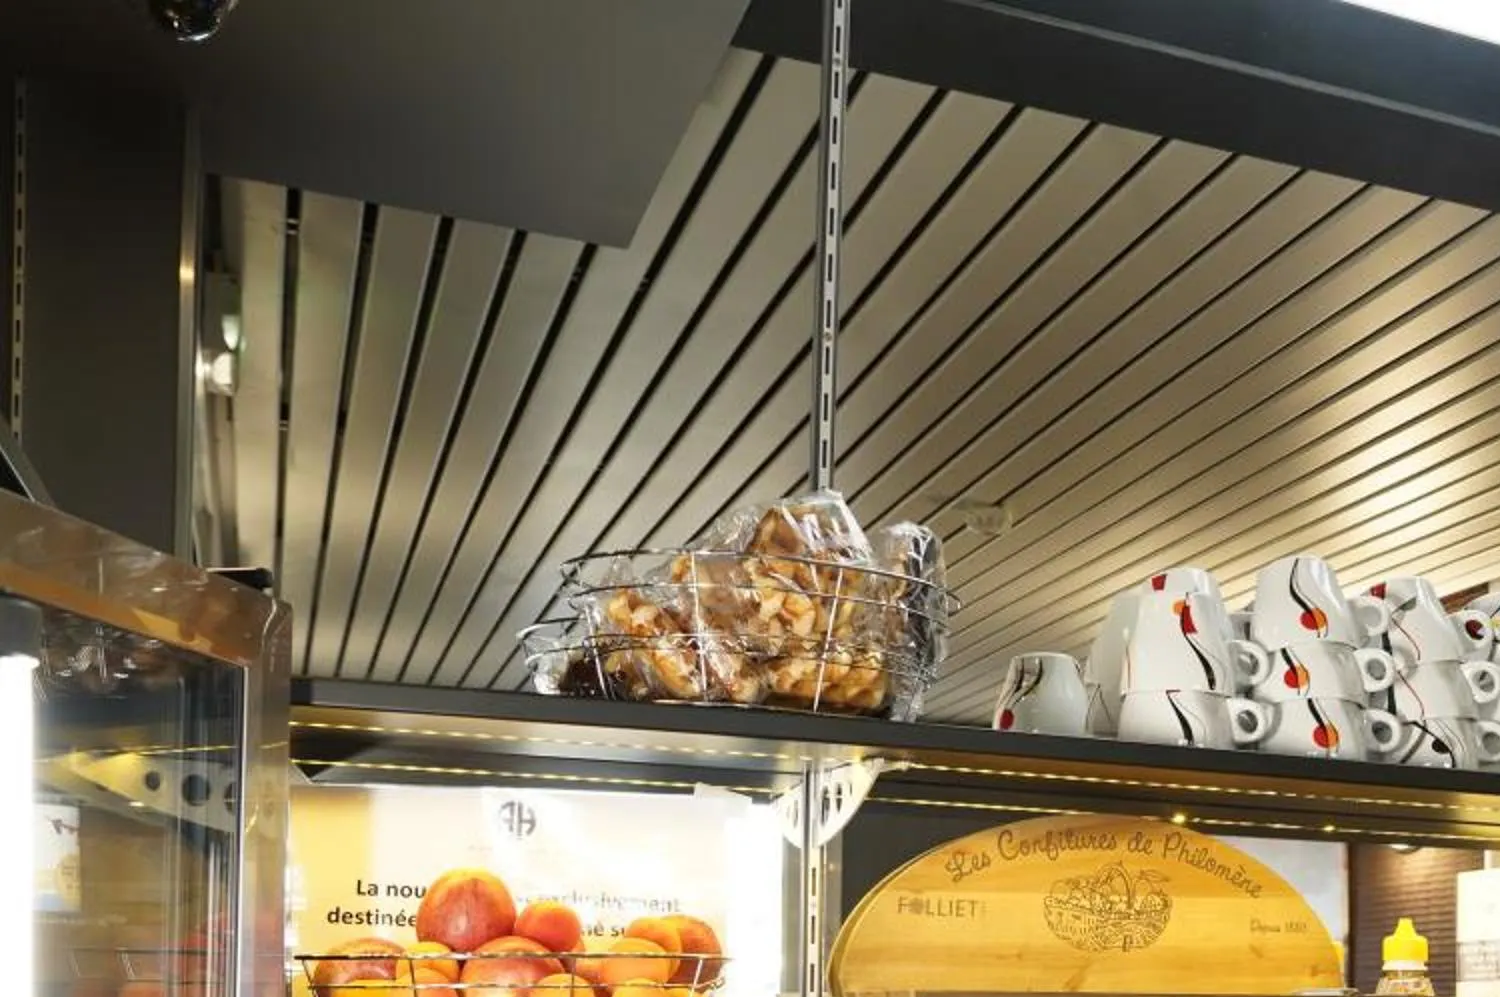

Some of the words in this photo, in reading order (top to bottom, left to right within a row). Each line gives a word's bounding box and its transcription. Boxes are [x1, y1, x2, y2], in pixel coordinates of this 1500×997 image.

[945, 850, 992, 883] Les
[998, 829, 1118, 861] Confitures
[1127, 831, 1153, 855] de
[1163, 831, 1264, 898] Philomène
[356, 880, 379, 896] La
[898, 891, 978, 918] FOLLIET
